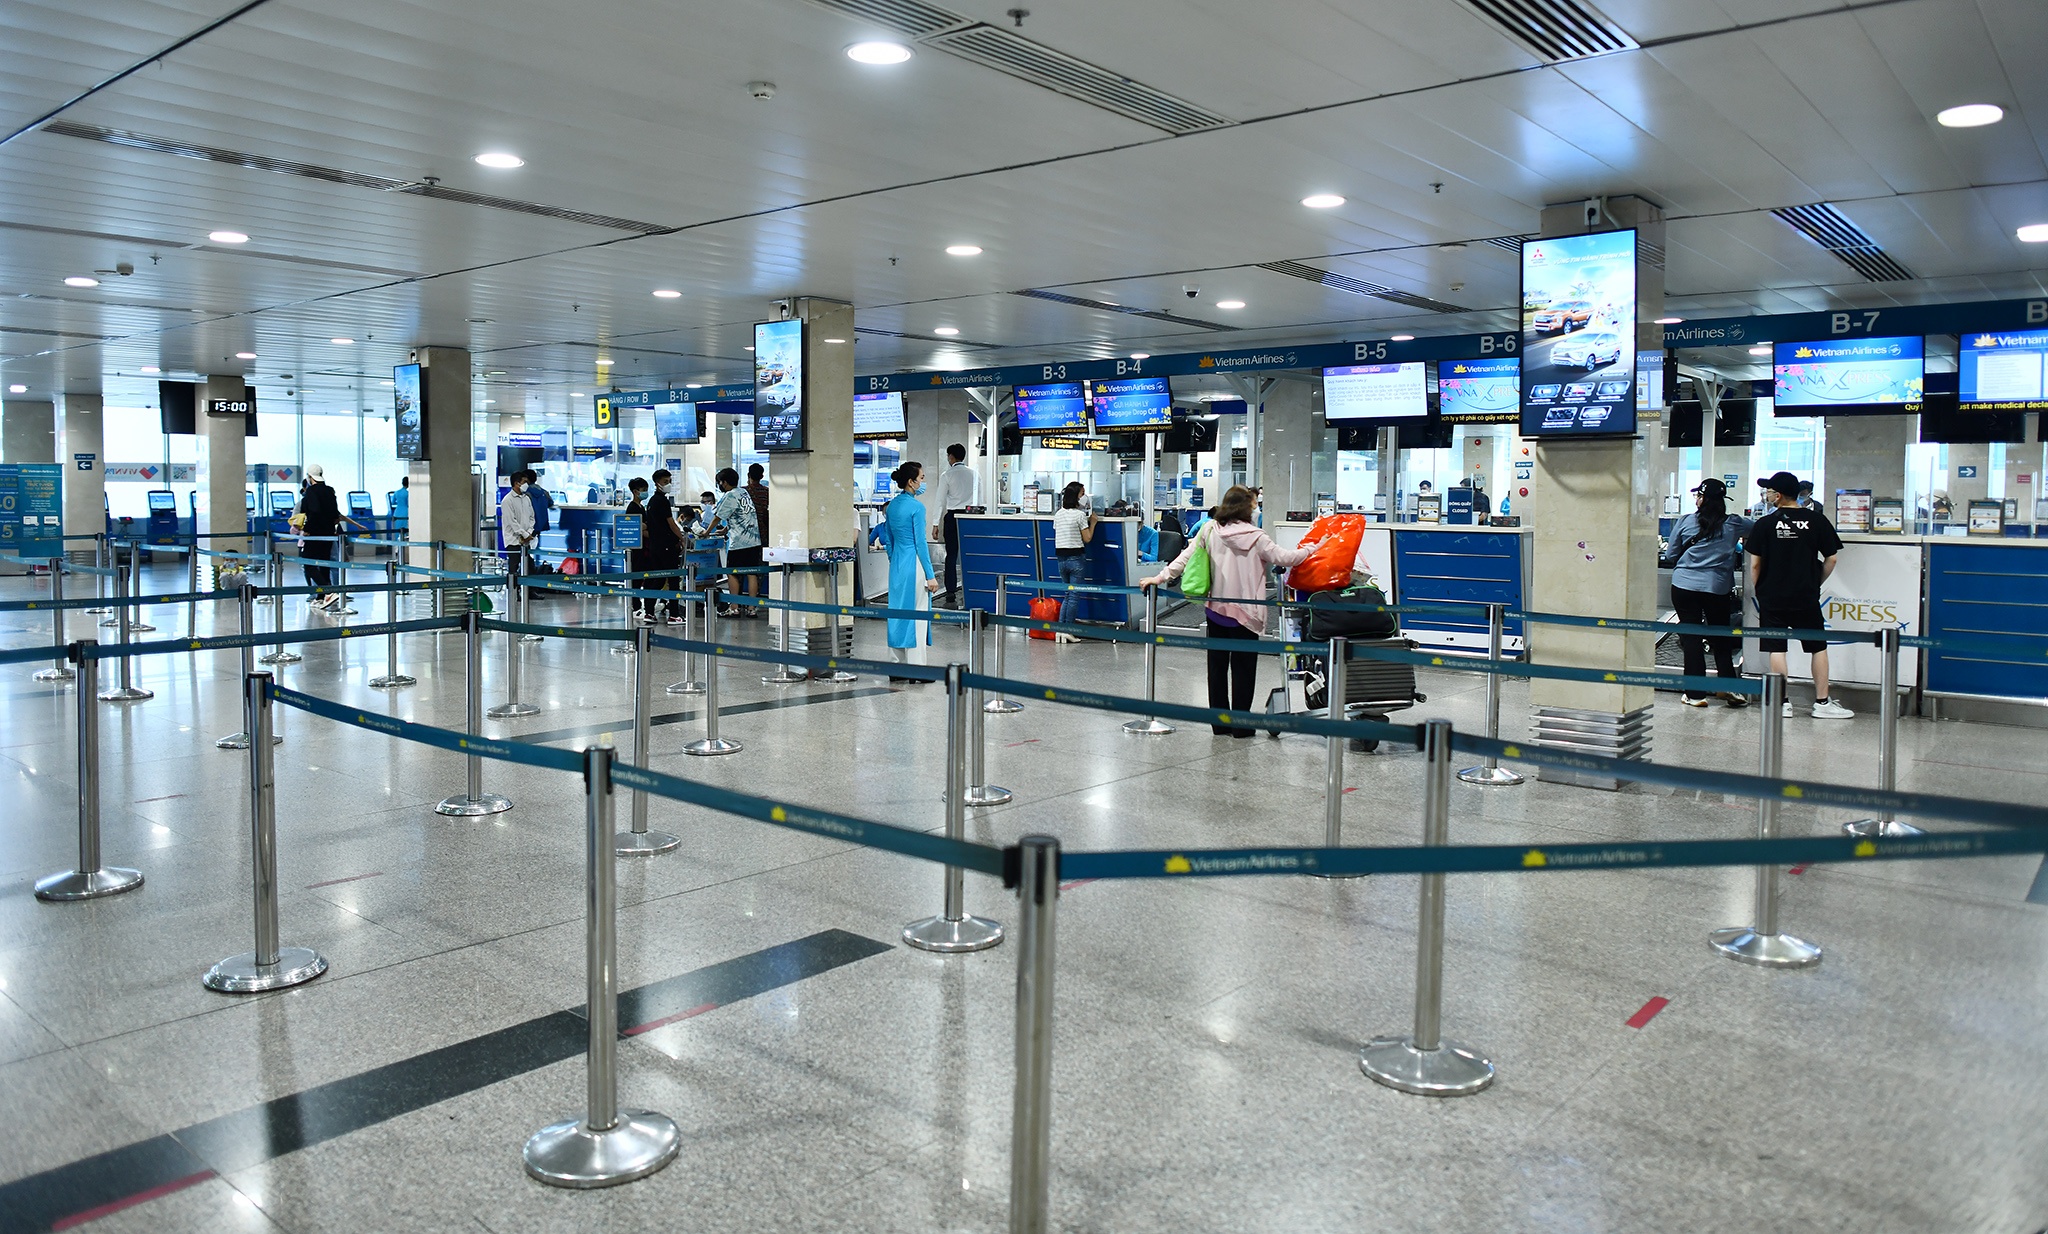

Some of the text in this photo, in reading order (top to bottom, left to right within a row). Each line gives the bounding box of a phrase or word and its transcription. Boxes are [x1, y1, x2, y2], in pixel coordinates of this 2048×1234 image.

[1831, 311, 1880, 334] B-7
[1354, 342, 1387, 361] B-5
[1480, 335, 1516, 354] B-6
[1043, 365, 1066, 380] B-3
[1116, 360, 1142, 376] B-4
[870, 377, 889, 390] B-2
[642, 393, 649, 404] B
[669, 390, 690, 402] B-1a
[214, 402, 247, 412] 15:00
[597, 398, 611, 424] B
[1107, 407, 1158, 418] Baggage Drop Off
[1971, 402, 1993, 410] make
[1994, 401, 2026, 409] medical
[1827, 600, 1897, 624] PRESS
